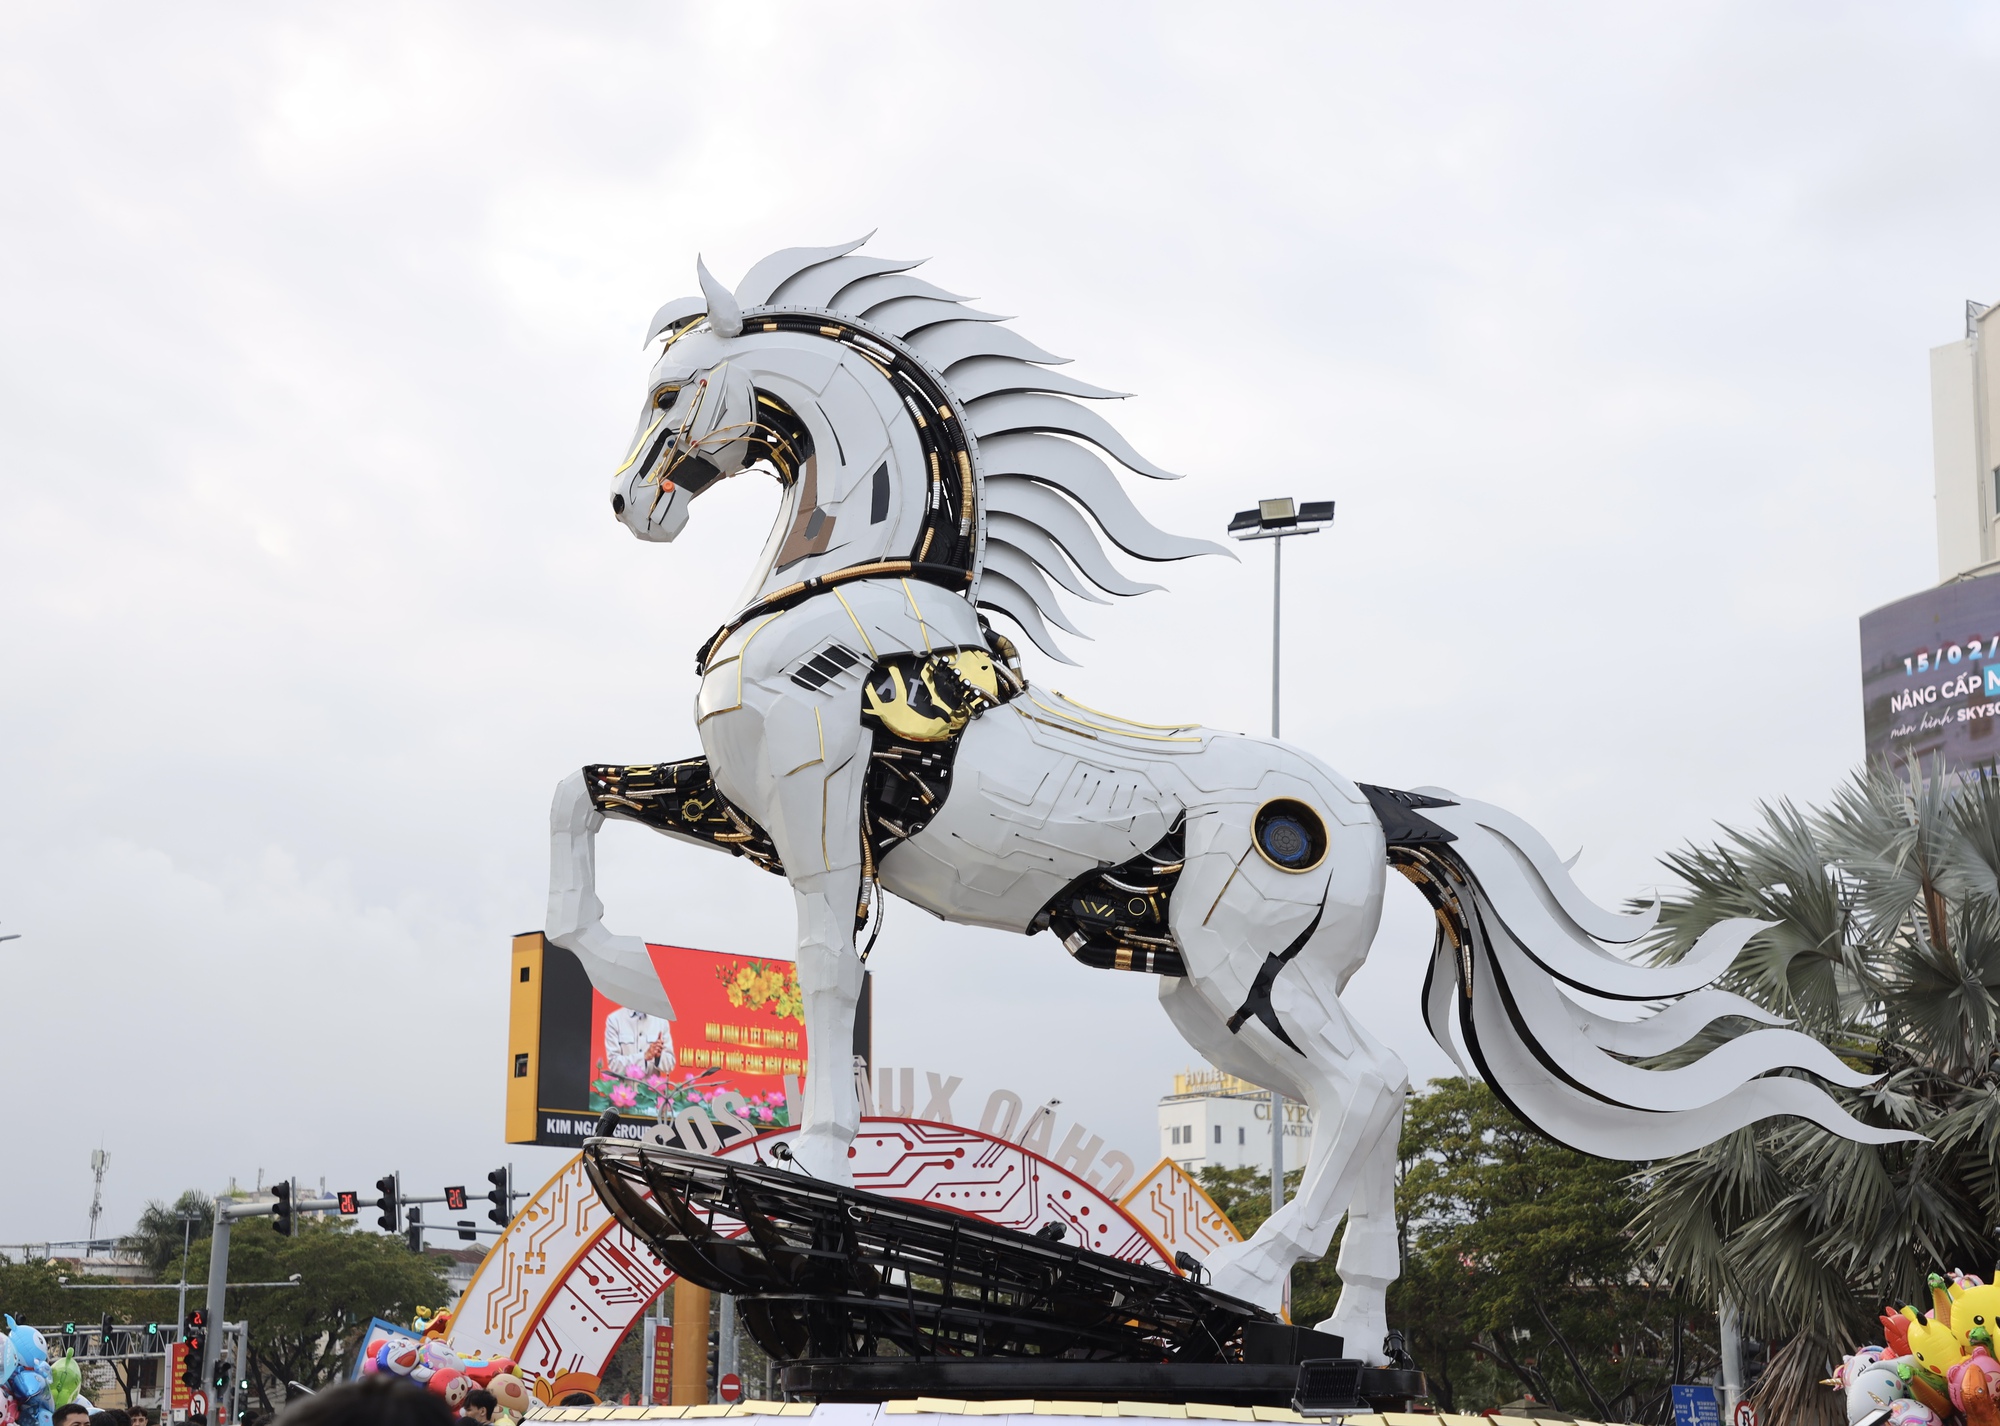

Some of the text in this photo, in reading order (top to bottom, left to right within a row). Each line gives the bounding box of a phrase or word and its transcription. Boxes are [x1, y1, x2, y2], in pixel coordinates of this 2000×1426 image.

[1891, 685, 1937, 714] NÂNG
[1941, 671, 1982, 698] CẤP
[1890, 722, 1917, 740] màn
[1920, 706, 1955, 731] hình
[750, 1021, 761, 1047] TẾT
[680, 1044, 693, 1067] LÀM
[695, 1049, 710, 1069] CHO
[546, 1118, 571, 1135] KIM
[574, 1120, 599, 1136] NGA
